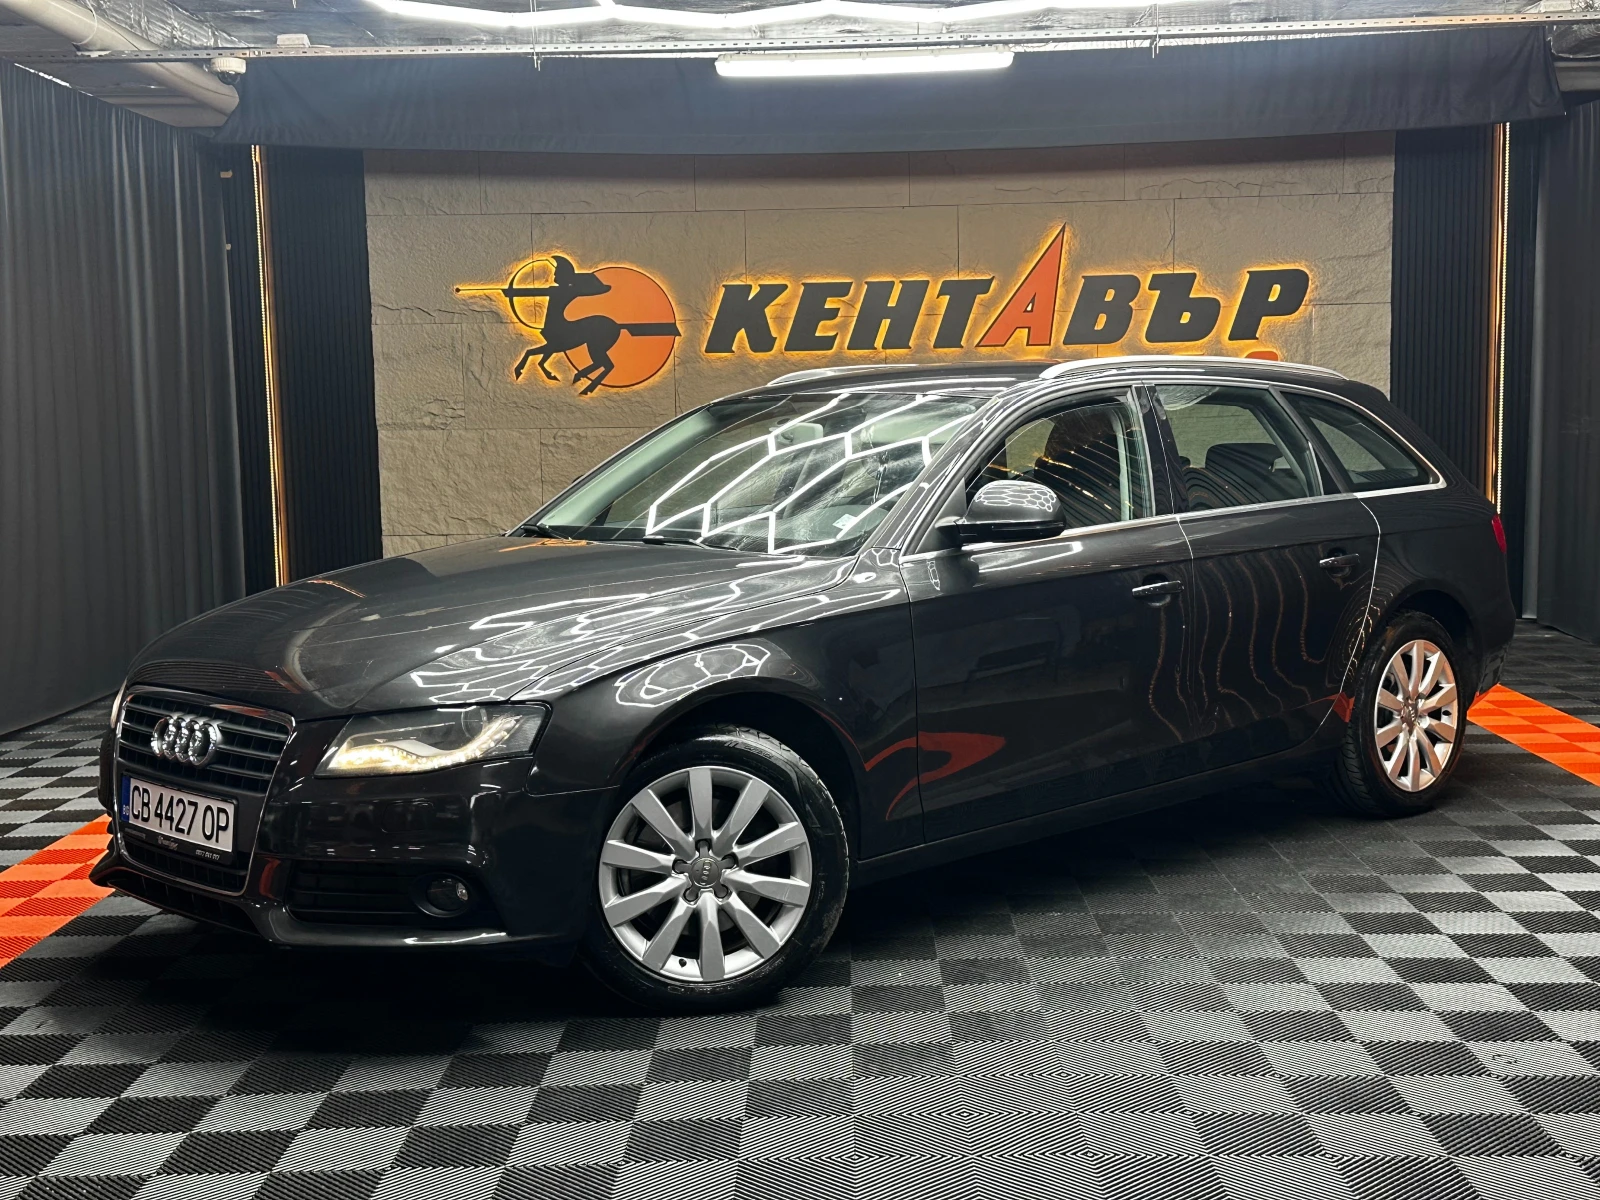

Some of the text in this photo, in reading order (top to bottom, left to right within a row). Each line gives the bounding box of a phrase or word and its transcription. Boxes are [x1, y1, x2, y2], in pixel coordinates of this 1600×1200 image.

[704, 222, 1310, 353] КЕНТАВЪР
[131, 785, 151, 822] CB
[154, 792, 198, 836] 4427
[202, 804, 230, 843] OP
